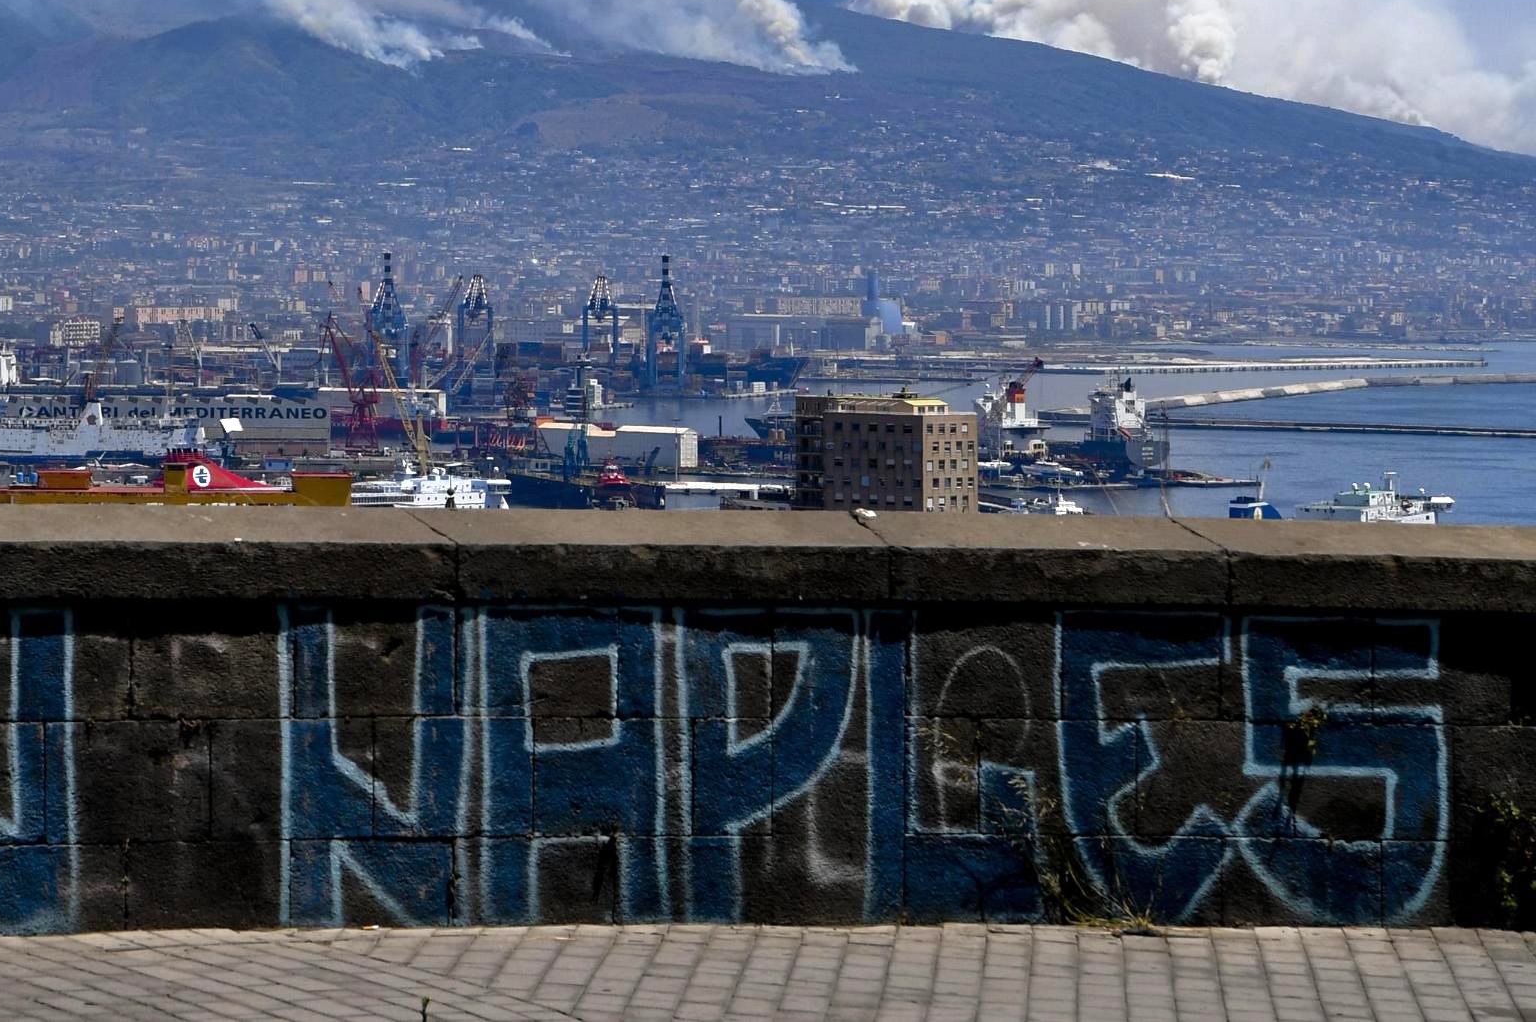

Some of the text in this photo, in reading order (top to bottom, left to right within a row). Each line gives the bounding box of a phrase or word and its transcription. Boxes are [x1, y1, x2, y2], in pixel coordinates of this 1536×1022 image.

[19, 406, 118, 419] CANTRI
[128, 406, 156, 418] del
[275, 603, 1451, 927] NAPLES
